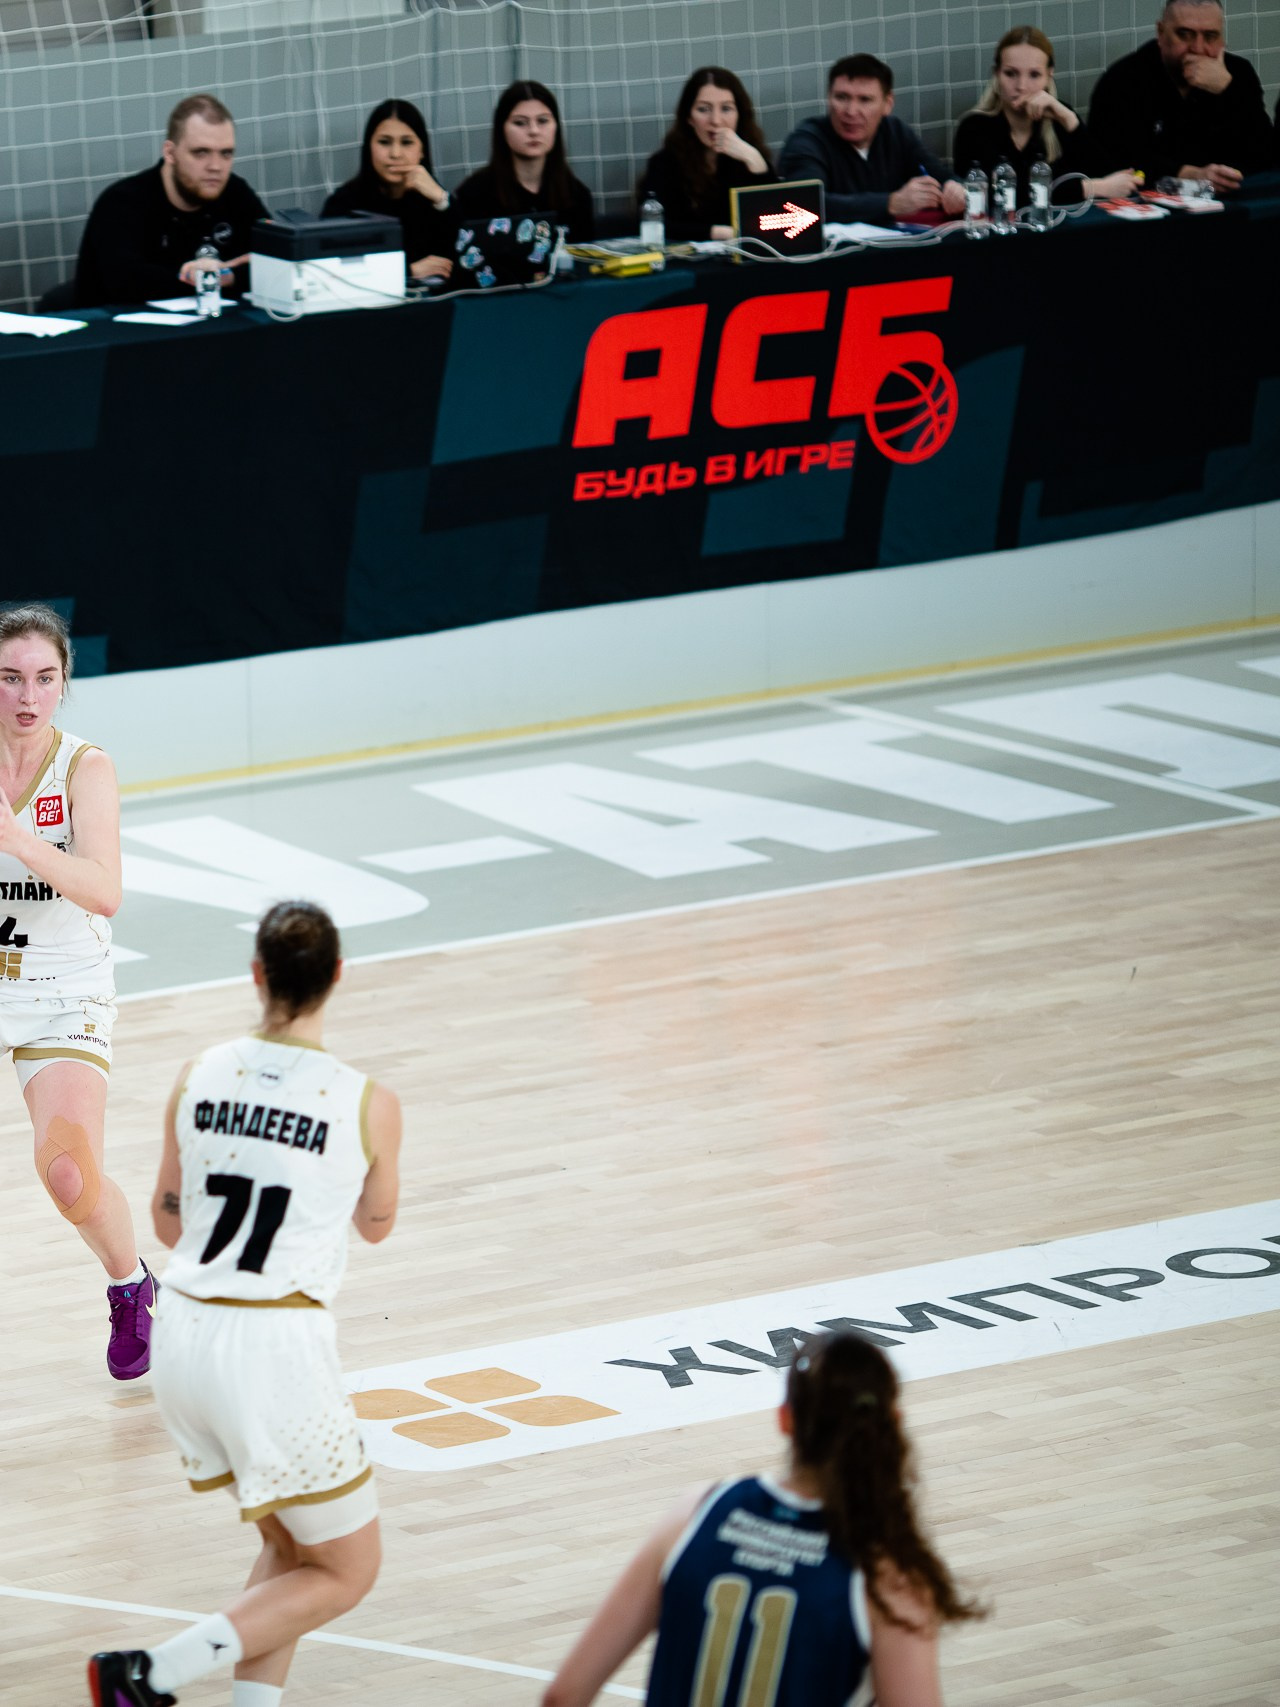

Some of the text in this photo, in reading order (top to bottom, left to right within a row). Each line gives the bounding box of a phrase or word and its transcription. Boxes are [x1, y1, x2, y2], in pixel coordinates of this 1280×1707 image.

[572, 276, 958, 464] АСБ
[573, 440, 856, 501] БУДЬ В ИГРЕ
[194, 1100, 329, 1156] ФАНДЕЕВА
[199, 1173, 292, 1275] 71
[603, 1234, 1280, 1389] ХИМПРО
[690, 1572, 798, 1707] 11
